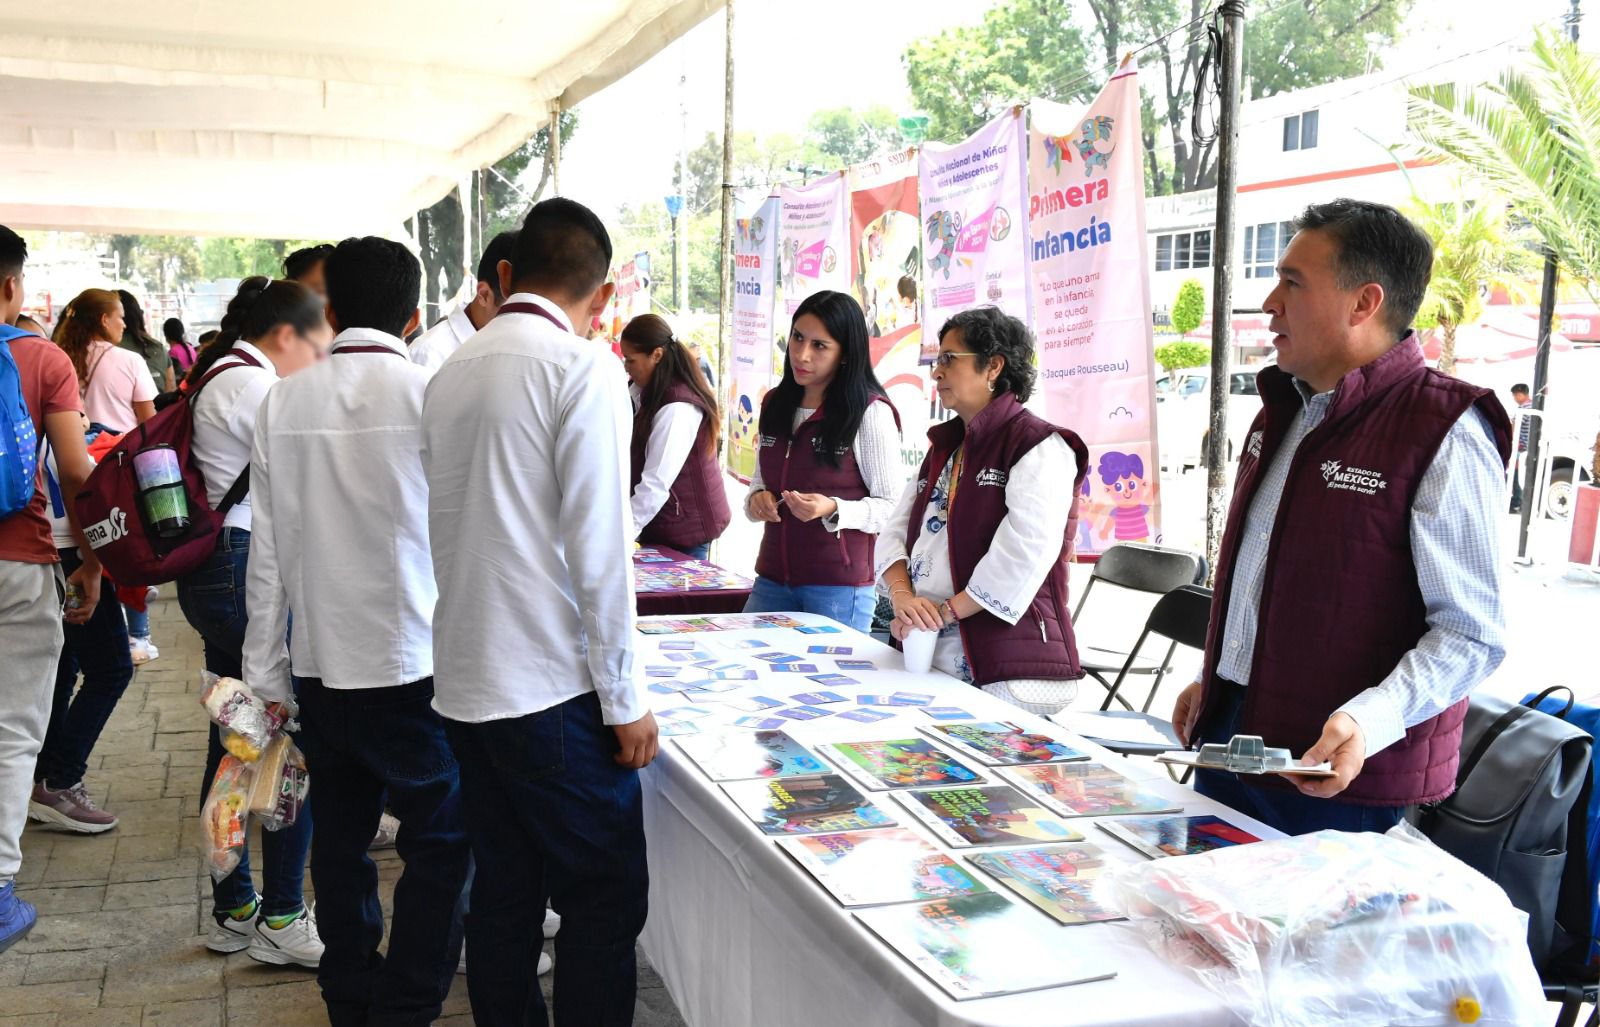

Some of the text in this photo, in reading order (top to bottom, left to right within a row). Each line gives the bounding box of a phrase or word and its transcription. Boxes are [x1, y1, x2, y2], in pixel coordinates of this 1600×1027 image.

[972, 152, 981, 163] de
[983, 144, 1007, 160] Niñas
[953, 162, 999, 183] Adolescentes
[1028, 178, 1109, 222] Primera
[735, 250, 761, 269] imera
[736, 277, 761, 296] ancia
[1064, 276, 1083, 287] uno
[1045, 297, 1054, 306] en
[1054, 311, 1063, 320] se
[1044, 340, 1061, 352] para
[1077, 359, 1129, 376] Rousseau)
[1346, 466, 1372, 477] ESTADO
[925, 791, 965, 817] PUNTITO
[952, 790, 994, 815] BARRITA
[965, 789, 993, 803] UNA
